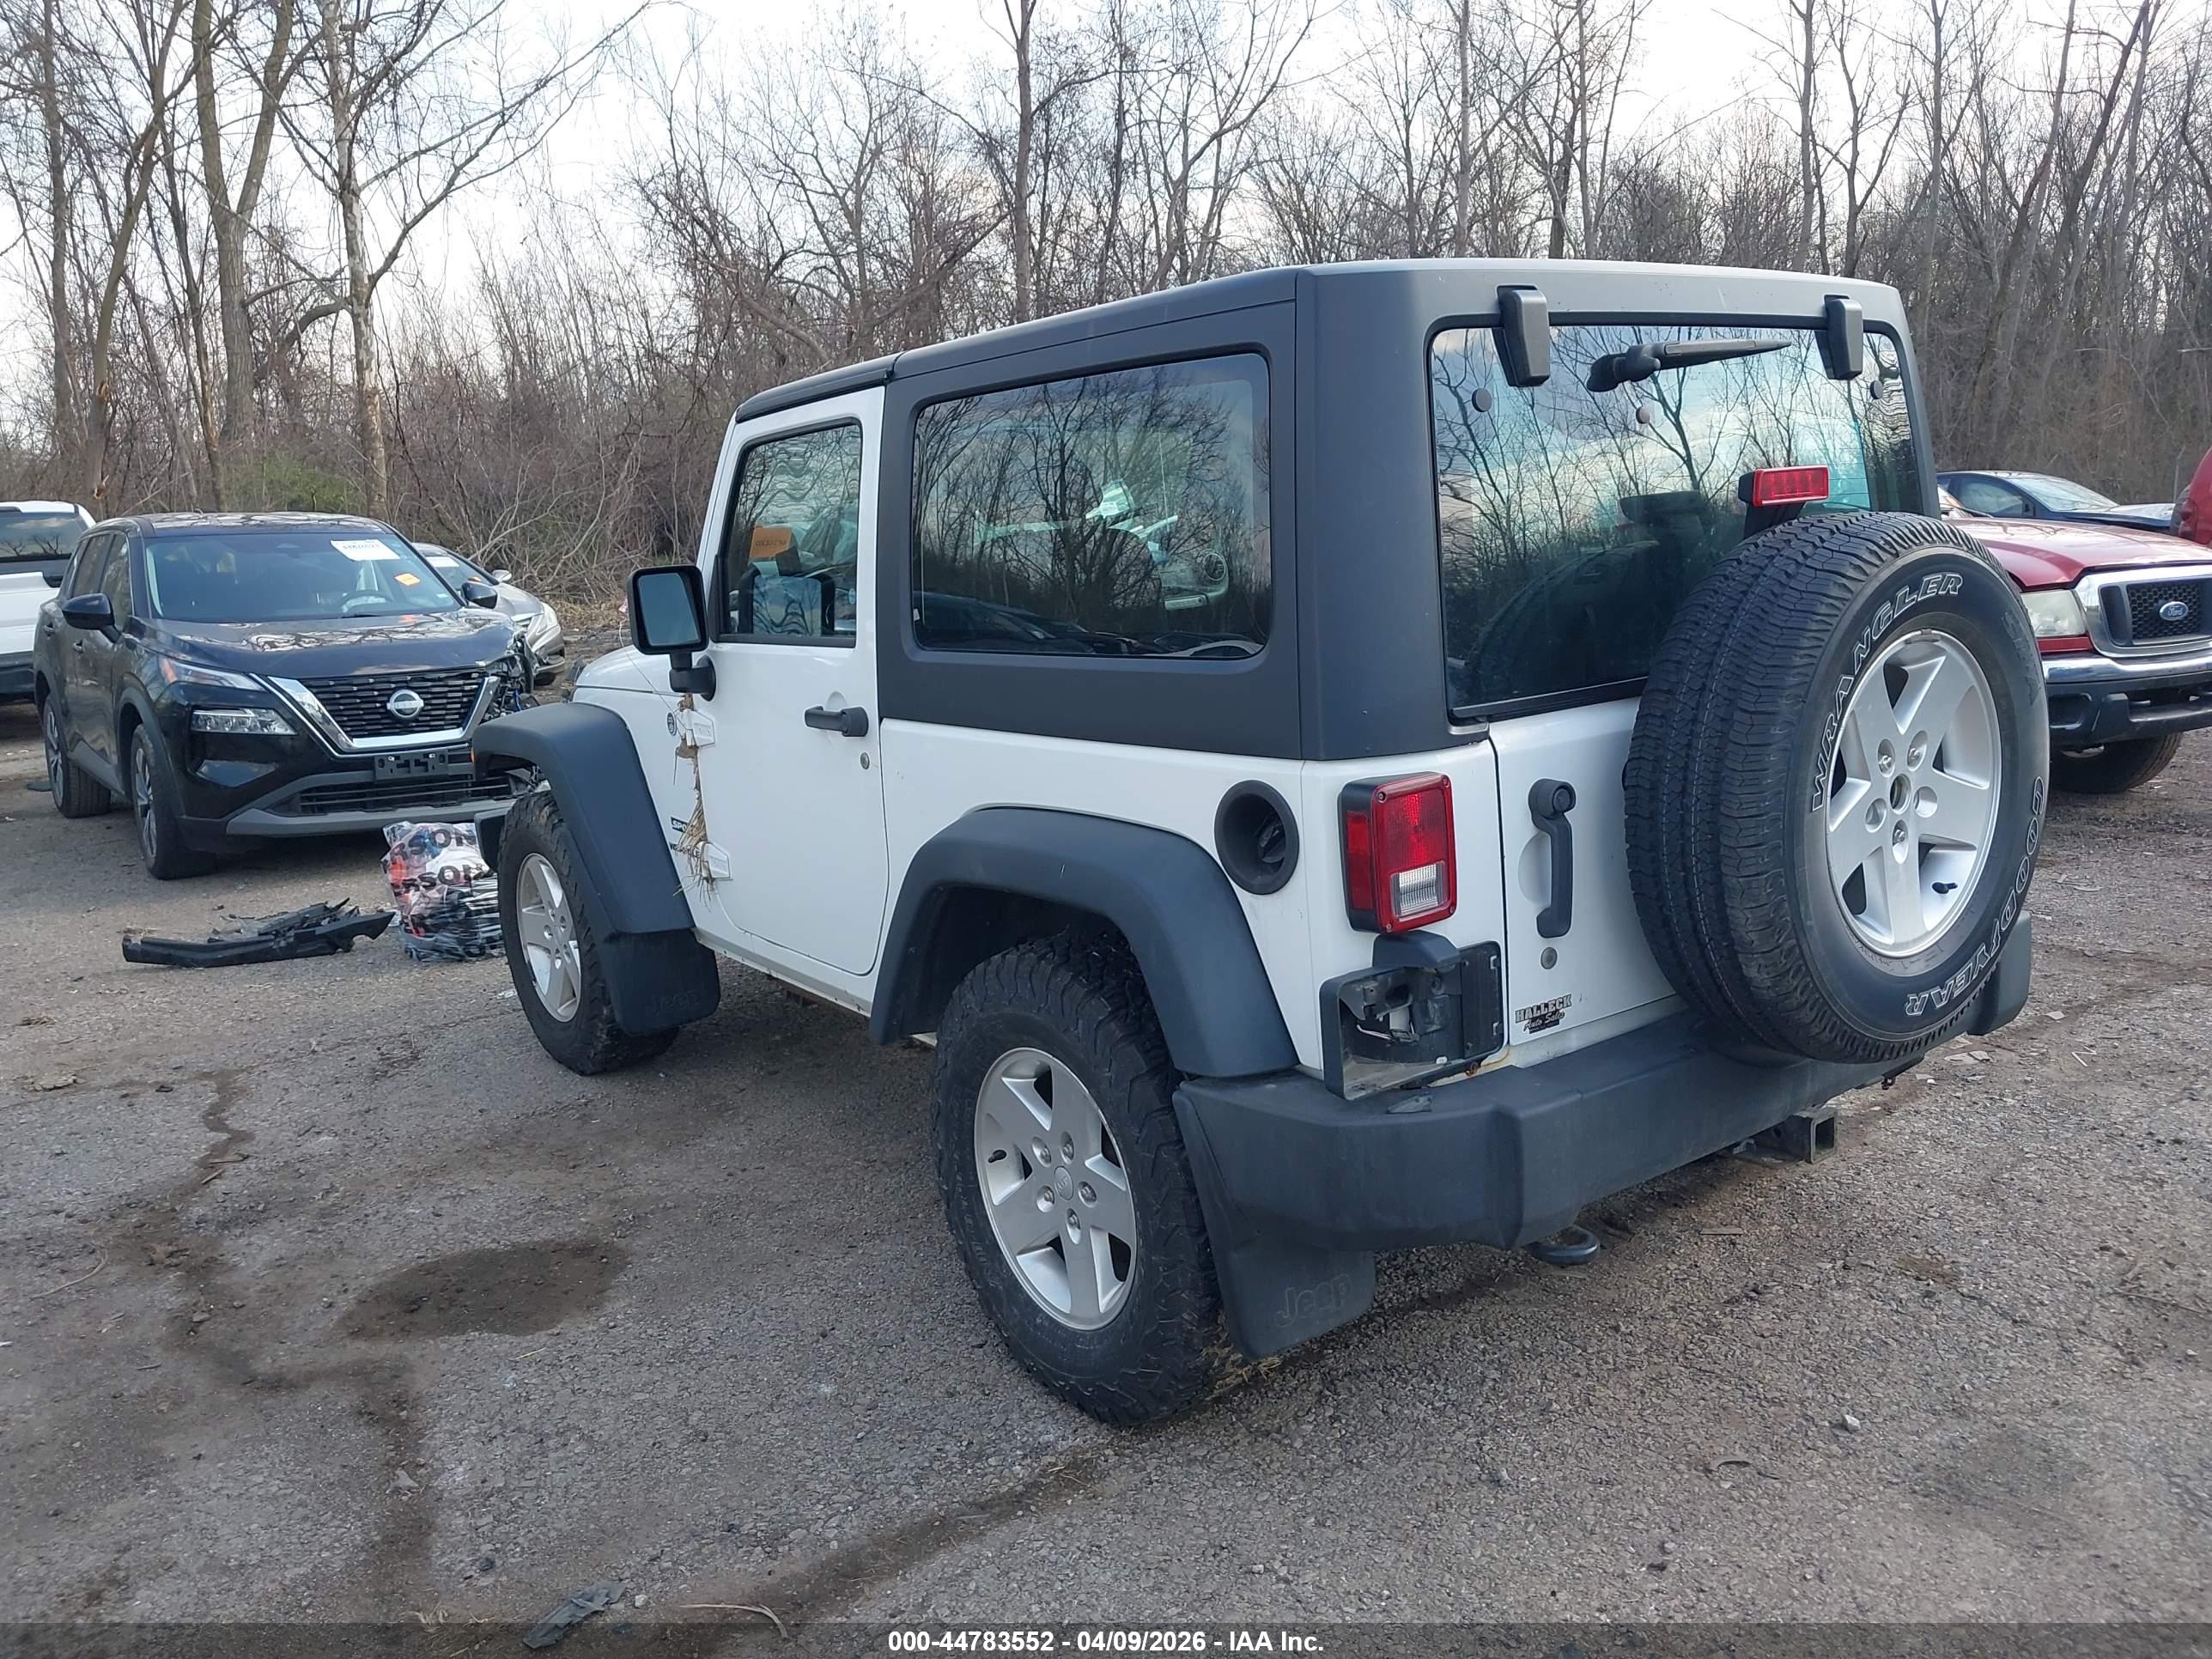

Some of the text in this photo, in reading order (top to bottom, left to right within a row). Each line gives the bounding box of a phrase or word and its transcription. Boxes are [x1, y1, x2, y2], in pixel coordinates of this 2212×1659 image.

[1811, 572, 1963, 811] WRANGLER
[672, 820, 689, 832] SPO
[1904, 775, 2045, 1017] GOODYEAR
[1515, 994, 1572, 1024] HALLECK
[1524, 1018, 1543, 1030] Auto
[1544, 1011, 1565, 1024] Sales
[1274, 1273, 1353, 1328] Jeep
